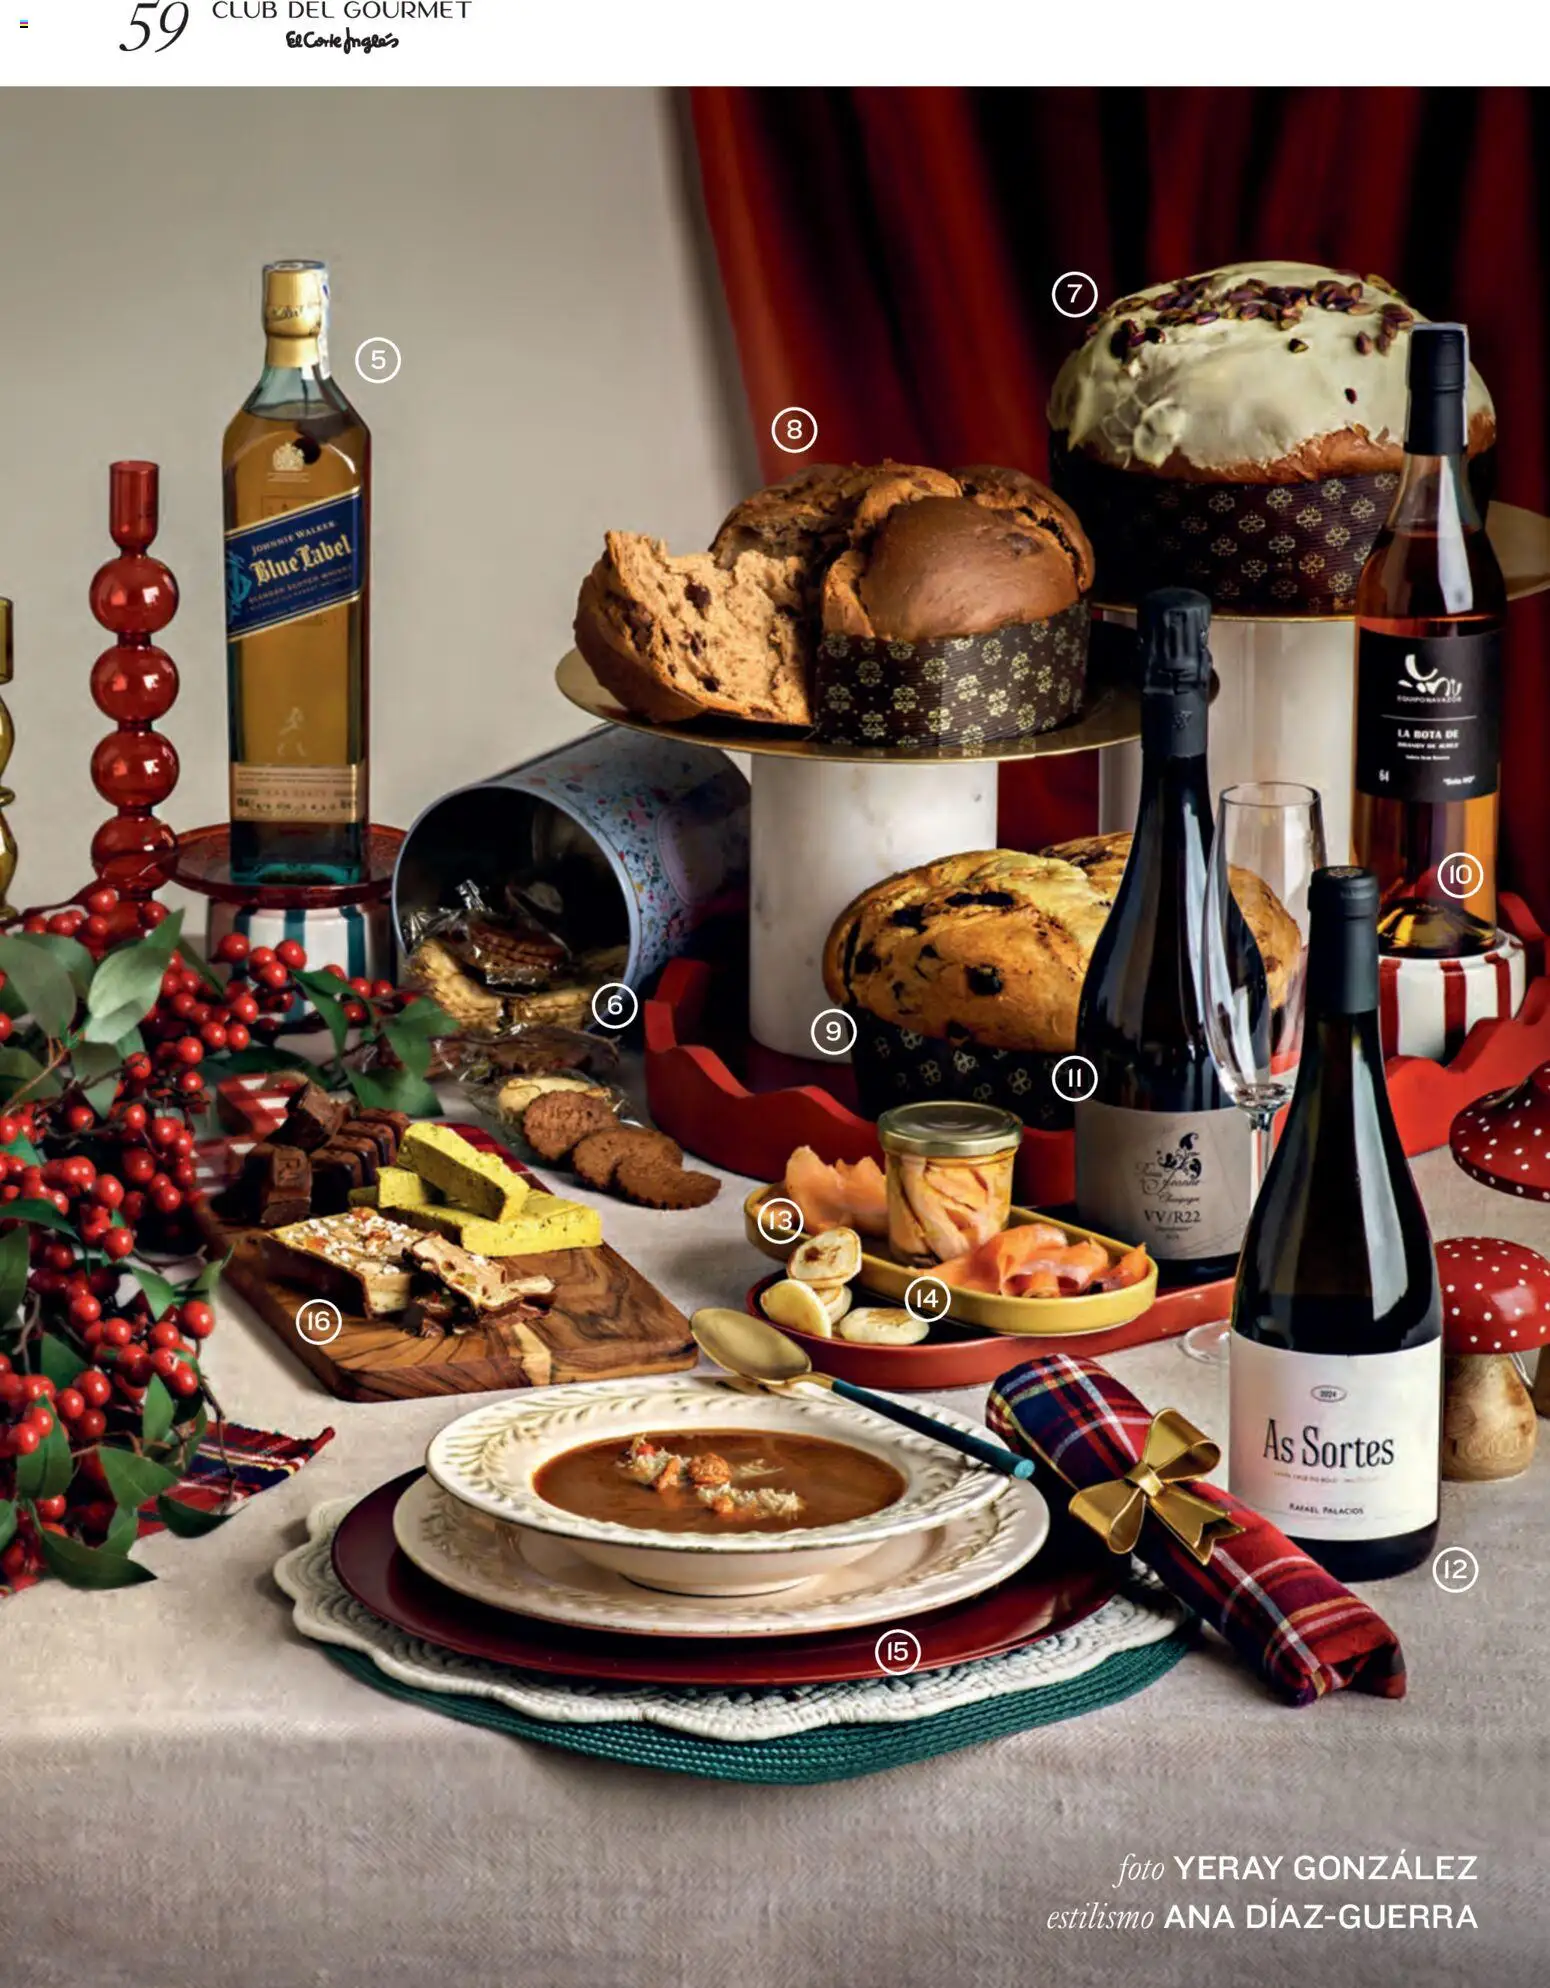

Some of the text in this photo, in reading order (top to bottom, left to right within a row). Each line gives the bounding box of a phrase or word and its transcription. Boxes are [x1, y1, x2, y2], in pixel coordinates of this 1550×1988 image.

[248, 533, 352, 587] Blue Label
[1397, 727, 1460, 740] LA BOTA DE
[1143, 1209, 1201, 1224] VV/R22
[1263, 1417, 1395, 1469] As Sortes
[1289, 1502, 1365, 1515] RAFAEL PALACIOS
